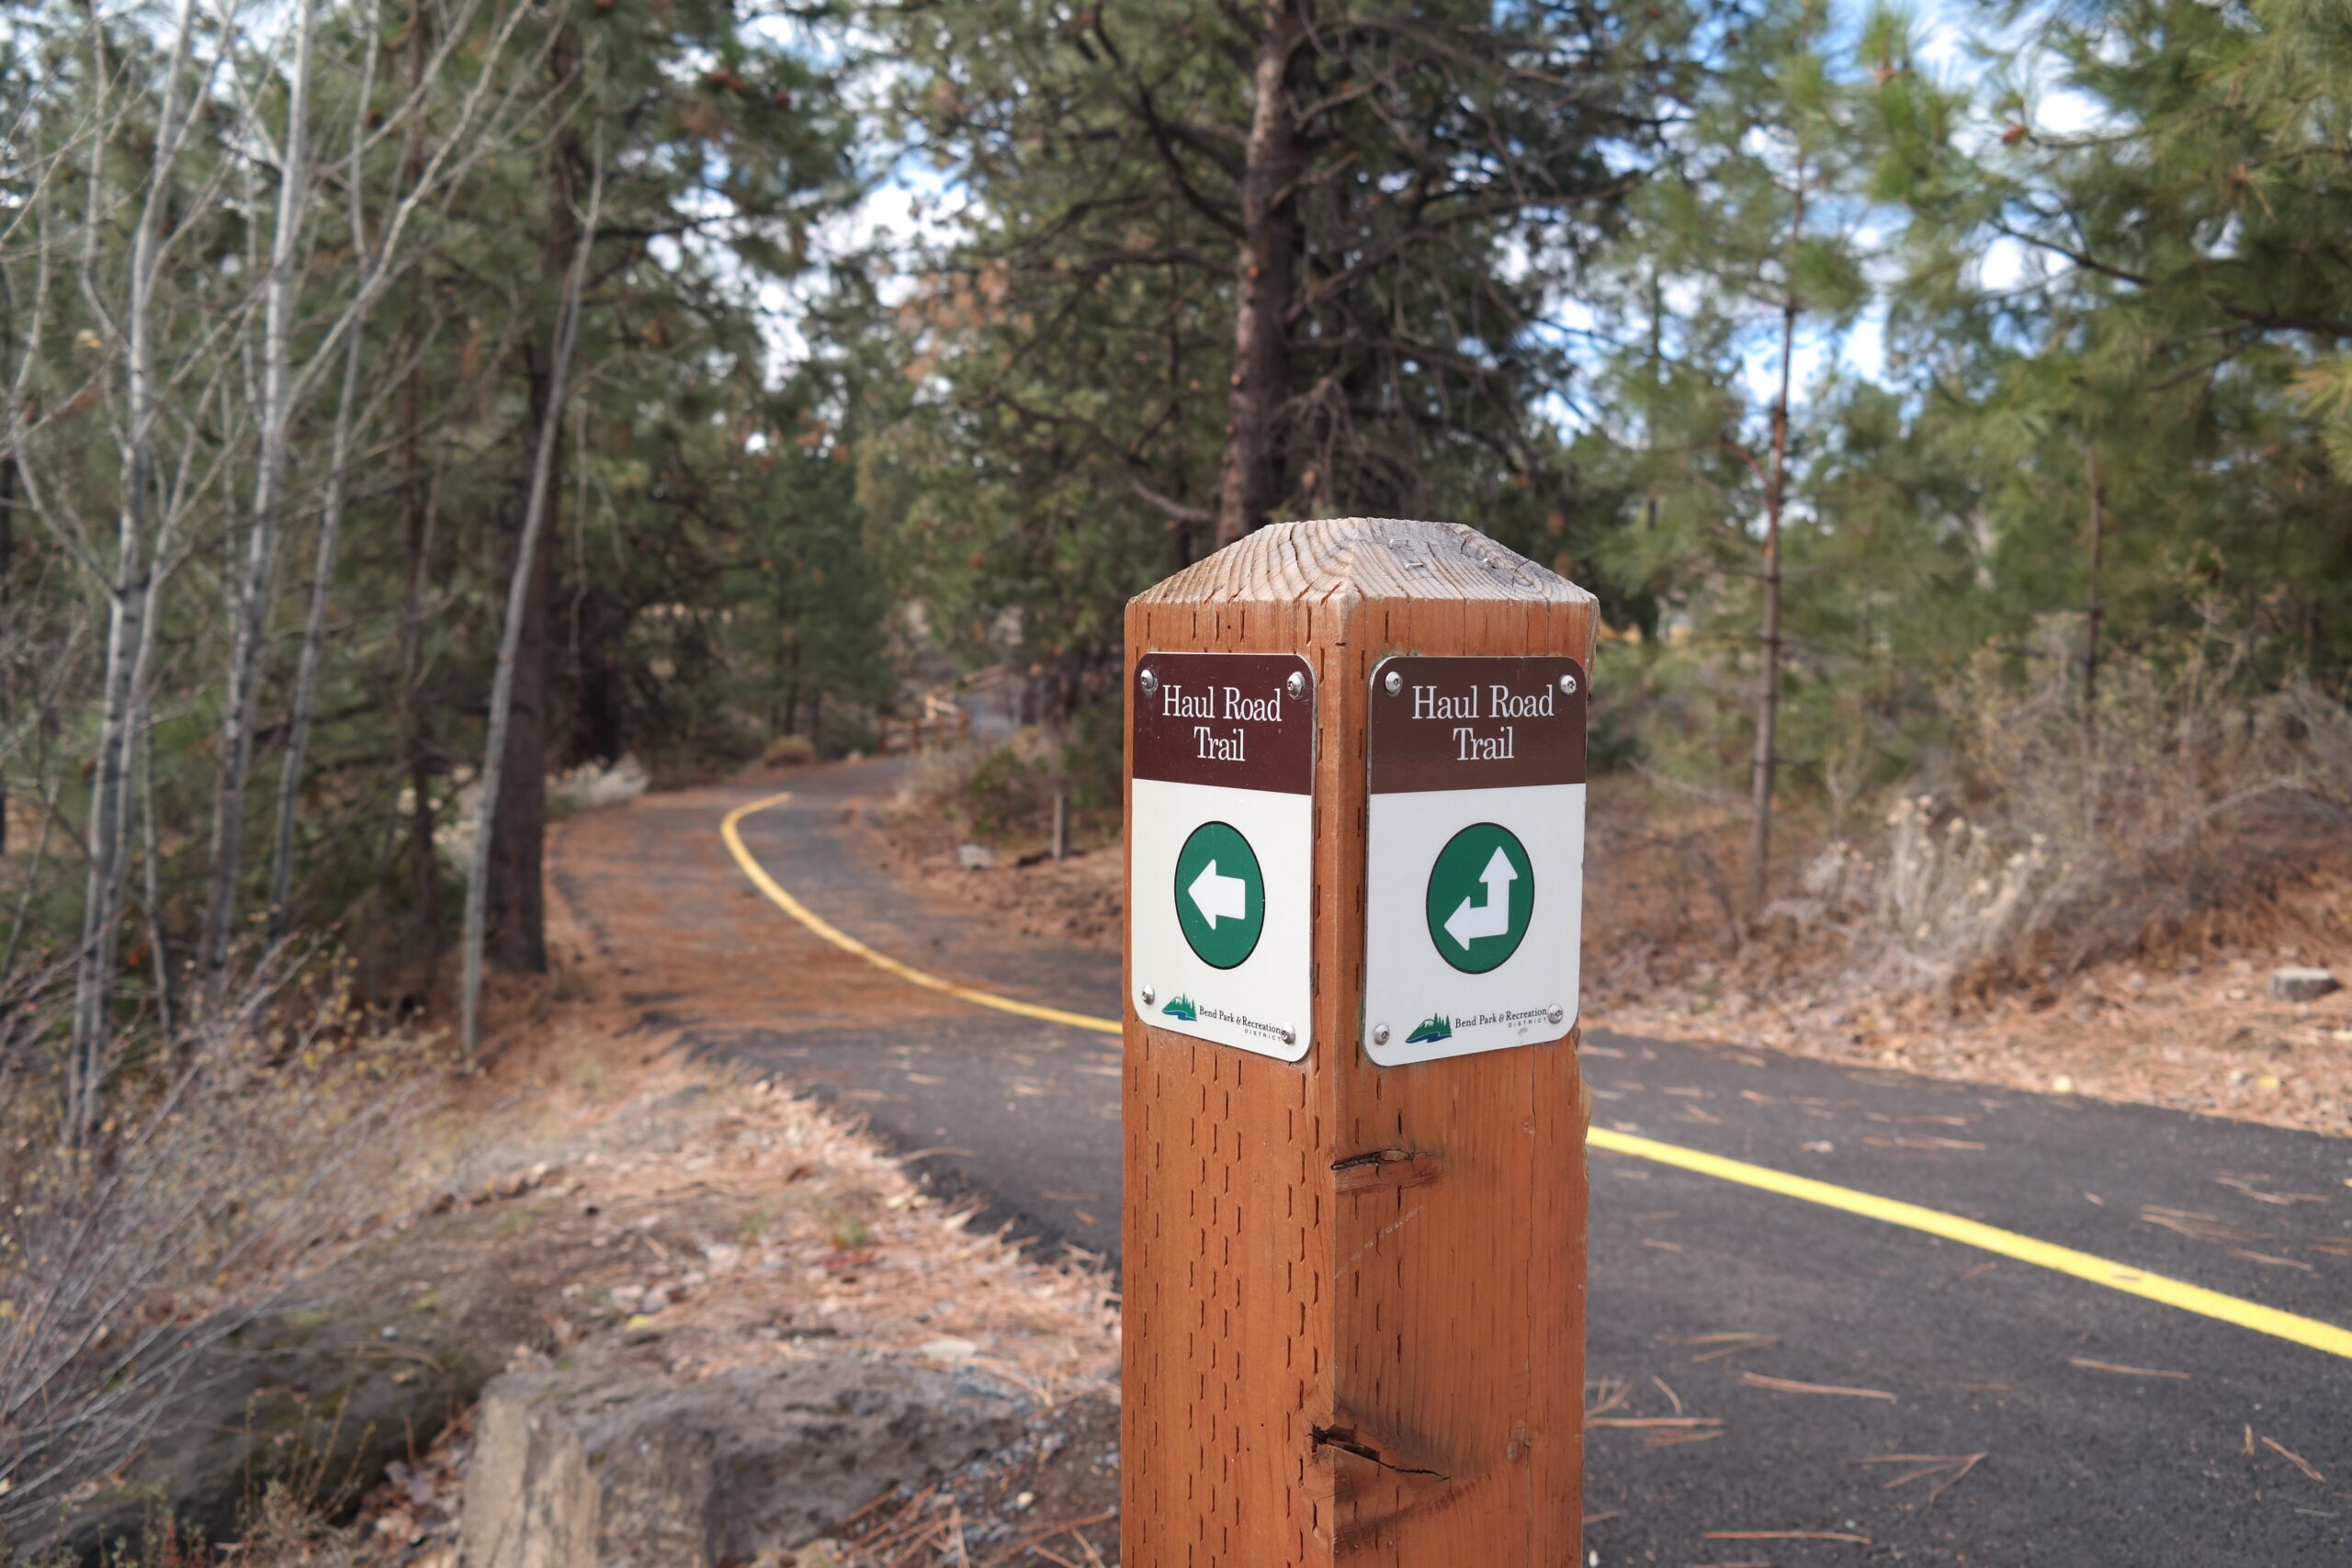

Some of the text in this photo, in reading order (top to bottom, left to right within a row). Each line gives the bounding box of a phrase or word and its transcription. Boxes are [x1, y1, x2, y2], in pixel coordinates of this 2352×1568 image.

[1161, 684, 1283, 722] Haul Road
[1411, 684, 1555, 719] Haul Road
[1193, 726, 1246, 761] Trail
[1453, 727, 1514, 761] Trail
[1199, 1006, 1281, 1034] Bend Park & Recreation
[1454, 1008, 1547, 1029] Bend Park & Recreation
[1508, 1017, 1547, 1028] DISTRICT
[1244, 1028, 1281, 1042] DISTRICT
